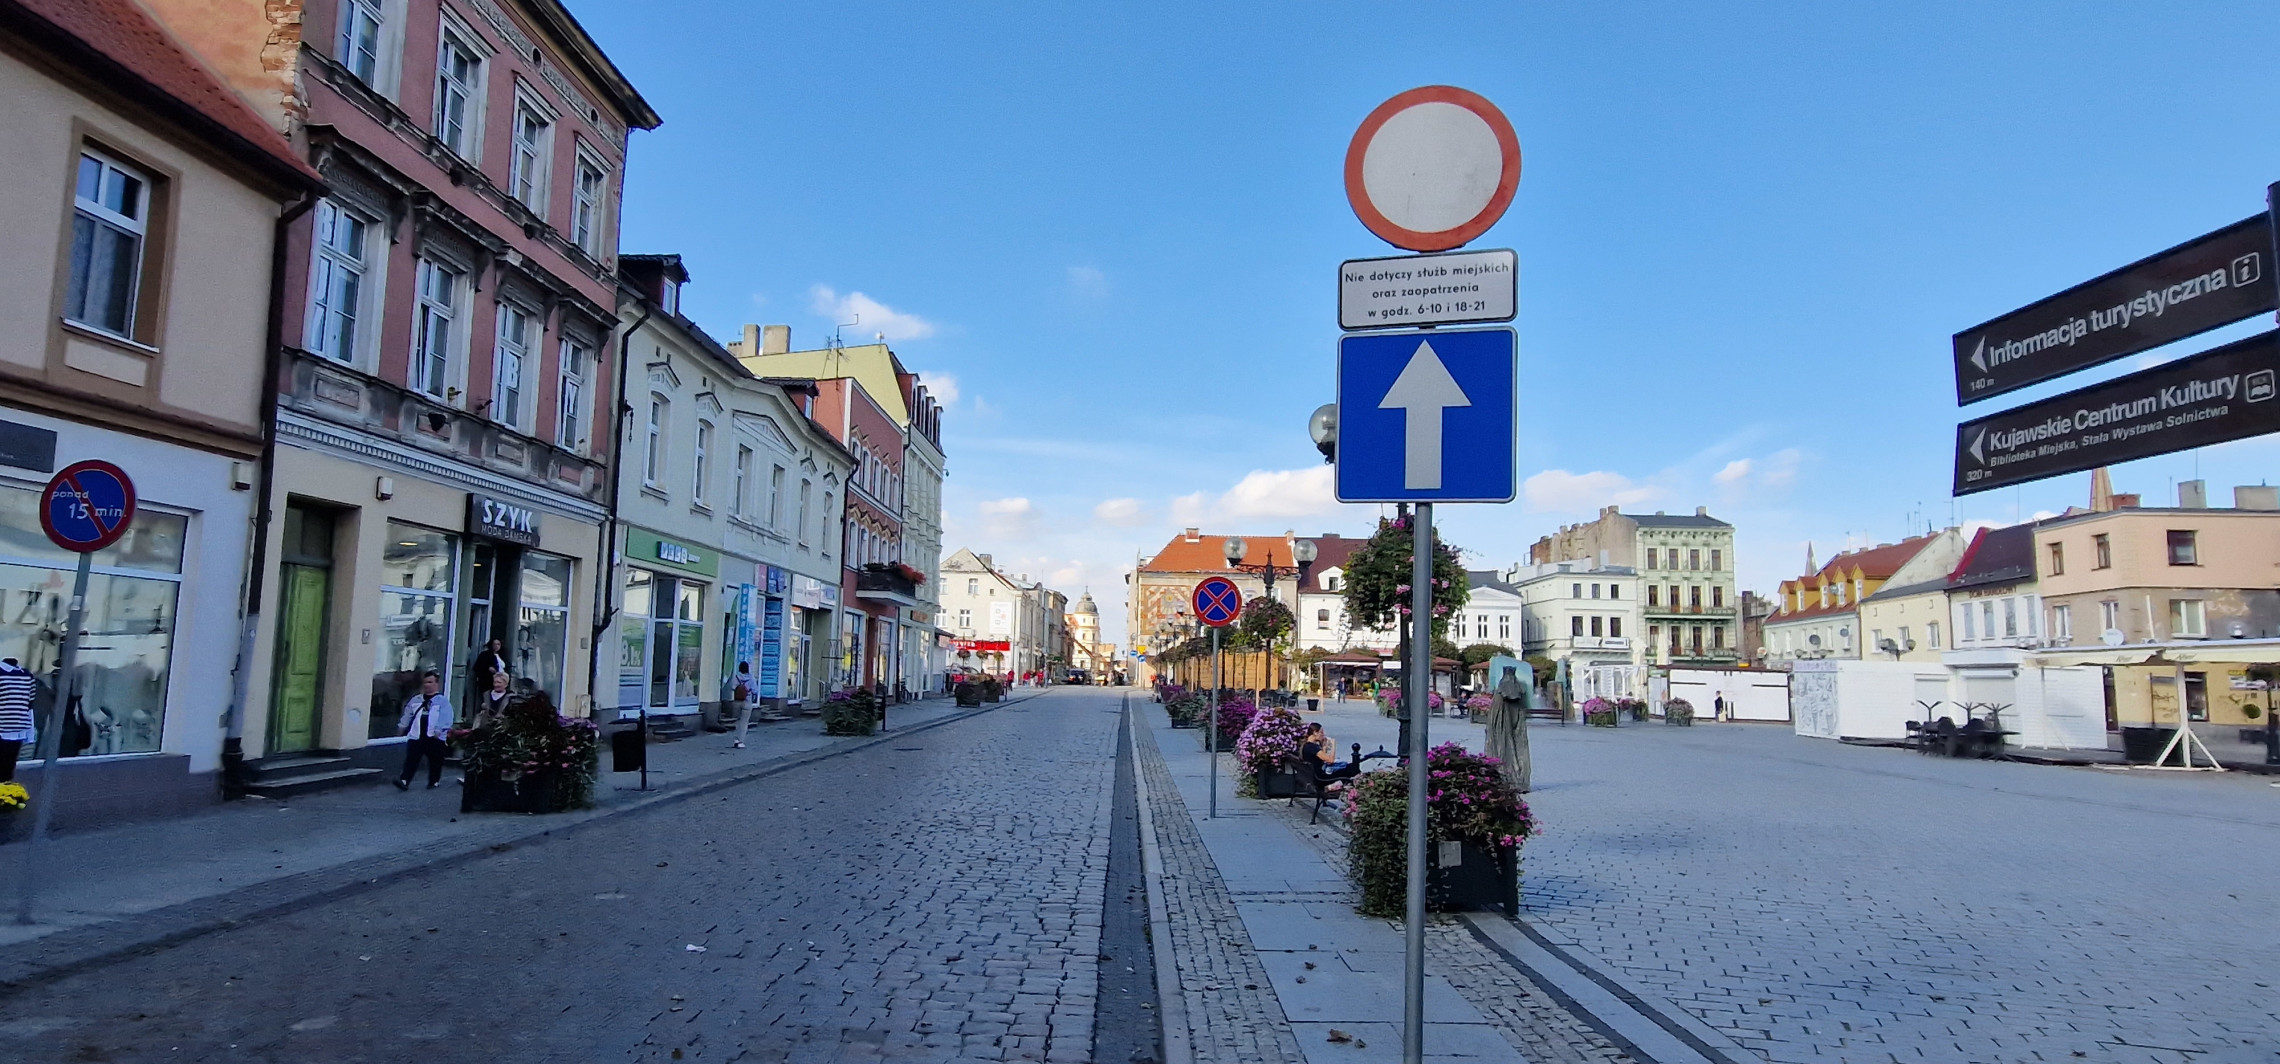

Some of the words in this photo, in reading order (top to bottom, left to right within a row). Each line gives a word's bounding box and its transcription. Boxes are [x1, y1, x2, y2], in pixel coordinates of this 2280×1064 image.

[1345, 273, 1365, 283] Nie
[1369, 269, 1412, 282] dotyczy
[1417, 266, 1448, 278] służb
[1452, 262, 1509, 276] miejskich
[1372, 288, 1397, 299] oraz
[1401, 282, 1479, 298] zaopatrzenia
[1368, 309, 1377, 318] w
[1381, 305, 1413, 319] godz.
[1417, 303, 1442, 315] 6-10
[1446, 302, 1450, 313] i
[1455, 301, 1486, 312] 18-21
[1990, 317, 2088, 367] Informacja
[2091, 267, 2228, 332] turystyczna
[1970, 378, 1987, 392] 140
[1987, 378, 1995, 386] m
[1990, 418, 2072, 452] Kujawskie
[2074, 396, 2157, 431] Centrum
[2160, 374, 2240, 410] Kultury
[1990, 450, 2036, 467] Biblioteka
[2039, 439, 2079, 458] Miejska,
[2082, 431, 2109, 447] Stała
[2112, 421, 2163, 441] Wystawa
[2166, 404, 2229, 428] Solnictwa
[1966, 469, 1983, 482] 320
[1984, 469, 1993, 478] m
[51, 490, 90, 500] ponad
[69, 503, 90, 520] 15
[95, 504, 127, 518] min.
[483, 499, 532, 533] SZYK
[481, 525, 502, 536] MODA
